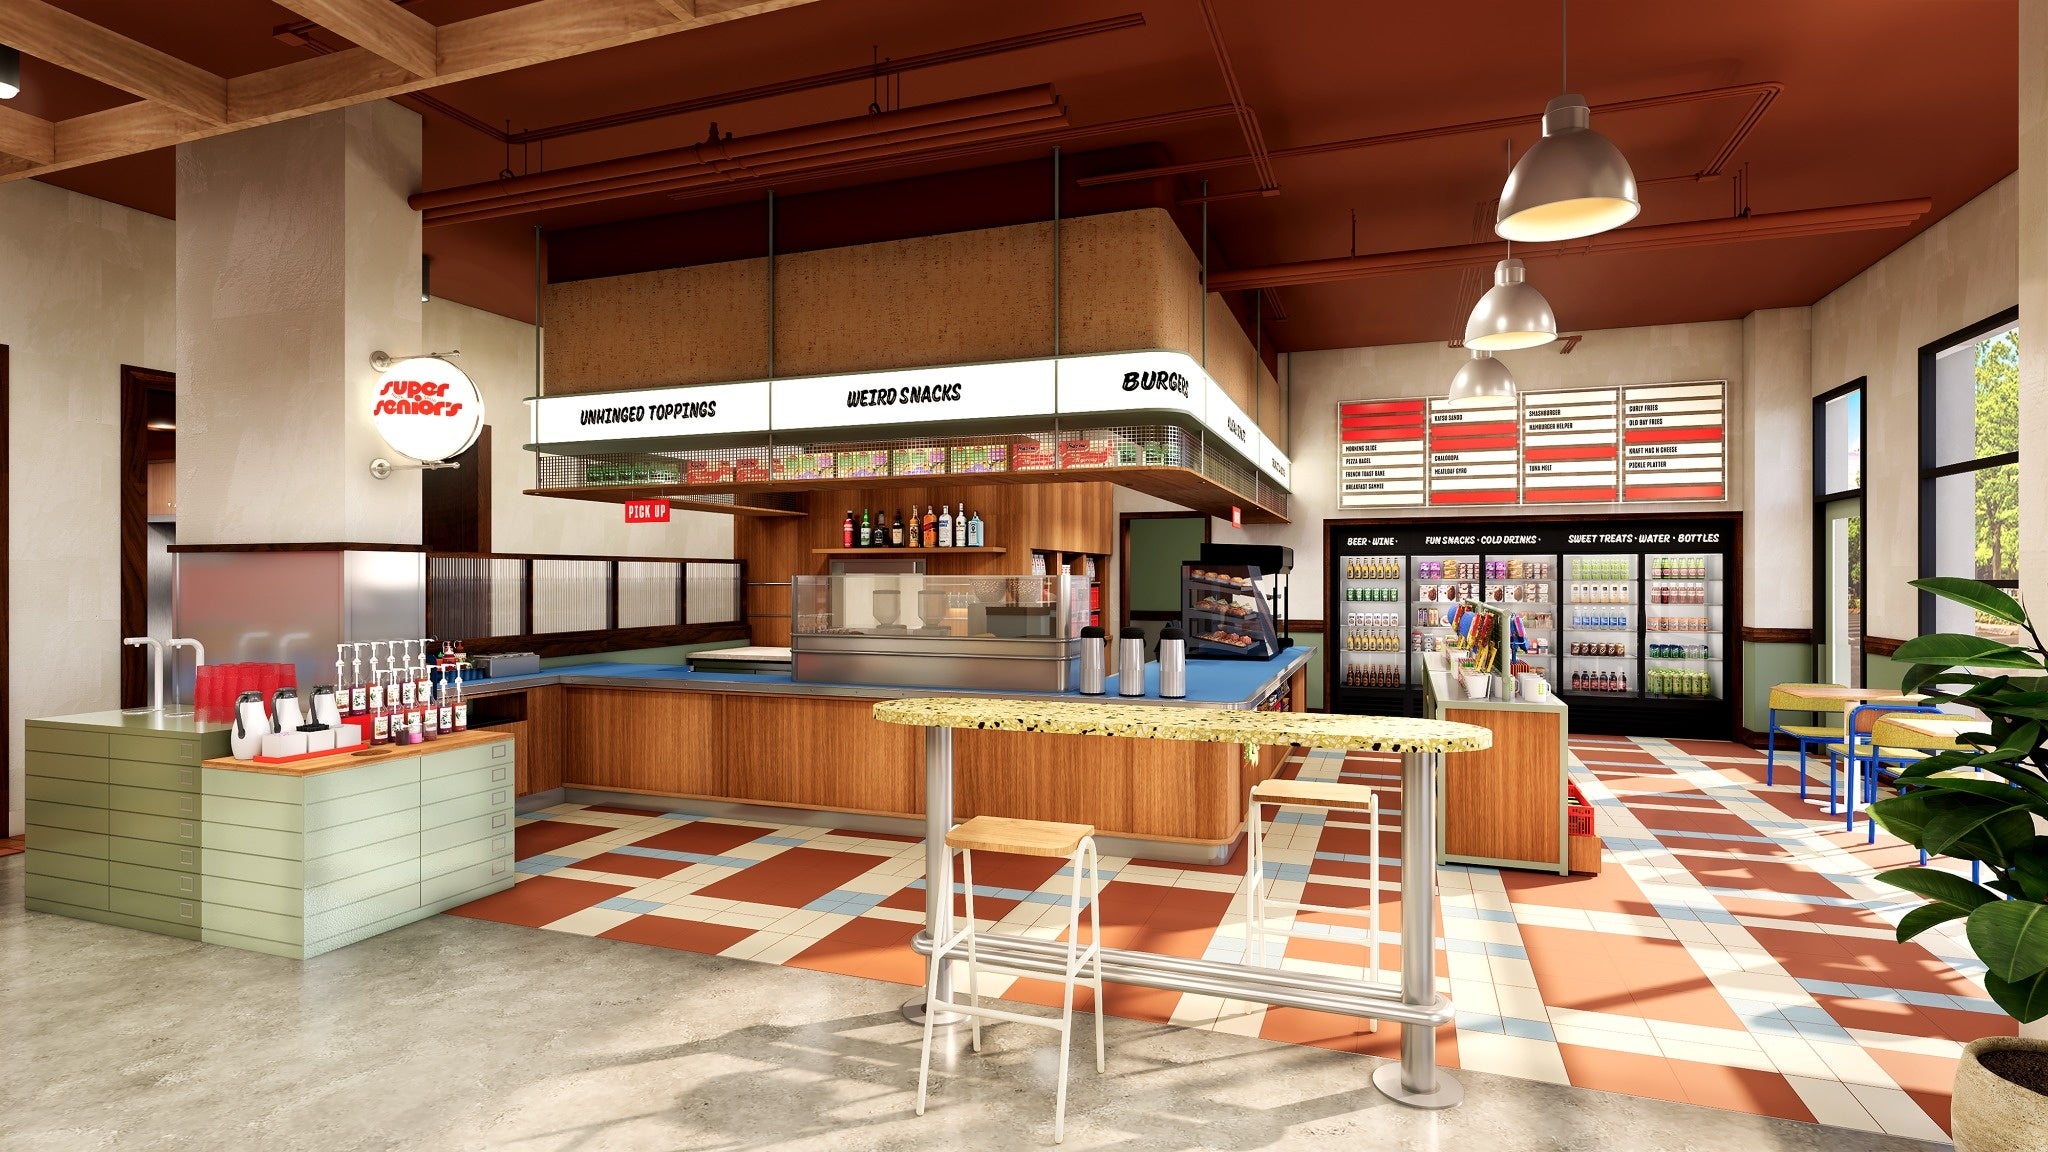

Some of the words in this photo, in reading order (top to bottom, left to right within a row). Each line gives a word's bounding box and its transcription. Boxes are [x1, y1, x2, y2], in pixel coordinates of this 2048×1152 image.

[379, 380, 450, 398] super
[846, 387, 897, 408] WEIRD
[899, 383, 962, 405] SNACKS
[373, 394, 463, 417] senior's
[580, 405, 645, 426] UNHINGED
[648, 400, 717, 421] TOPPINGS
[1628, 461, 1646, 469] PICKLE
[629, 505, 650, 518] PICK
[654, 504, 666, 518] UP
[1347, 537, 1368, 546] BEER
[1372, 537, 1395, 546] WINE
[1425, 536, 1442, 545] FUN
[1441, 536, 1476, 545] SNACKS
[1480, 535, 1503, 545] COLD
[1503, 535, 1537, 544] DRINKS
[1568, 534, 1598, 543] SWEET
[1599, 534, 1633, 543] TREATS
[1638, 534, 1671, 543] WATER
[1677, 533, 1720, 543] BOTTLES
